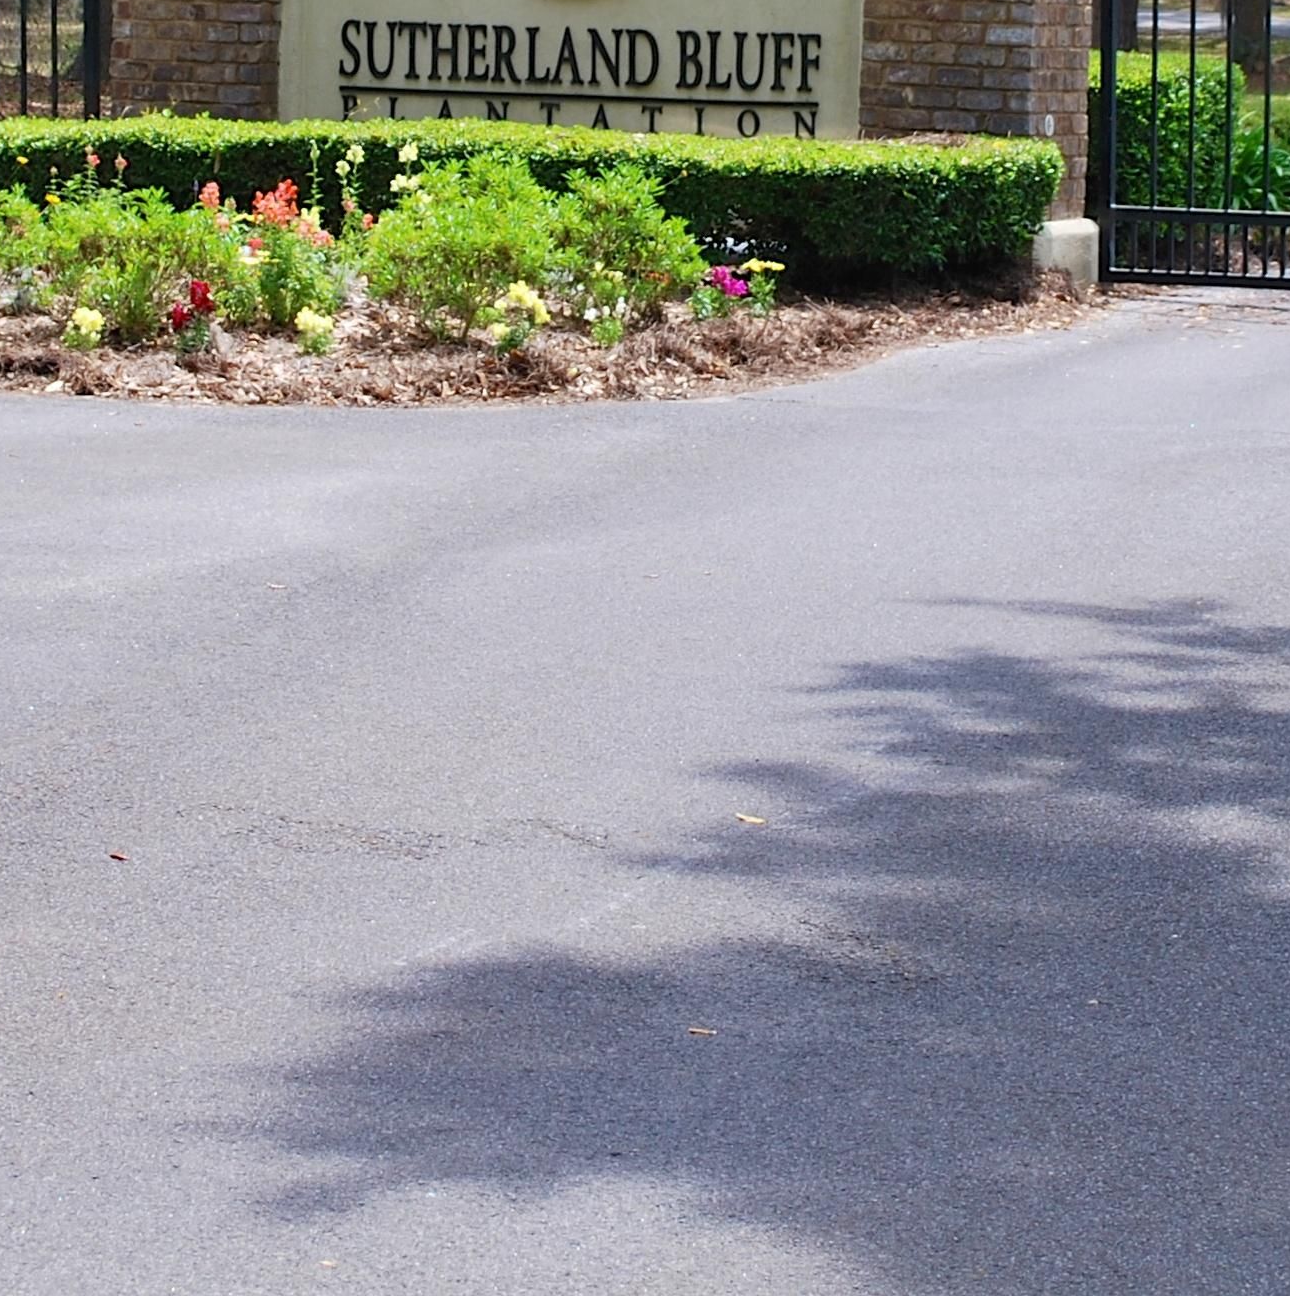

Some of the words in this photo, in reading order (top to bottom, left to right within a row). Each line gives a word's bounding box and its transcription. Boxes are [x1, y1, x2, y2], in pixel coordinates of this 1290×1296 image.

[339, 19, 660, 87] SUTHERLAND
[675, 30, 822, 92] BLUFF
[341, 94, 818, 139] PLANTATION
